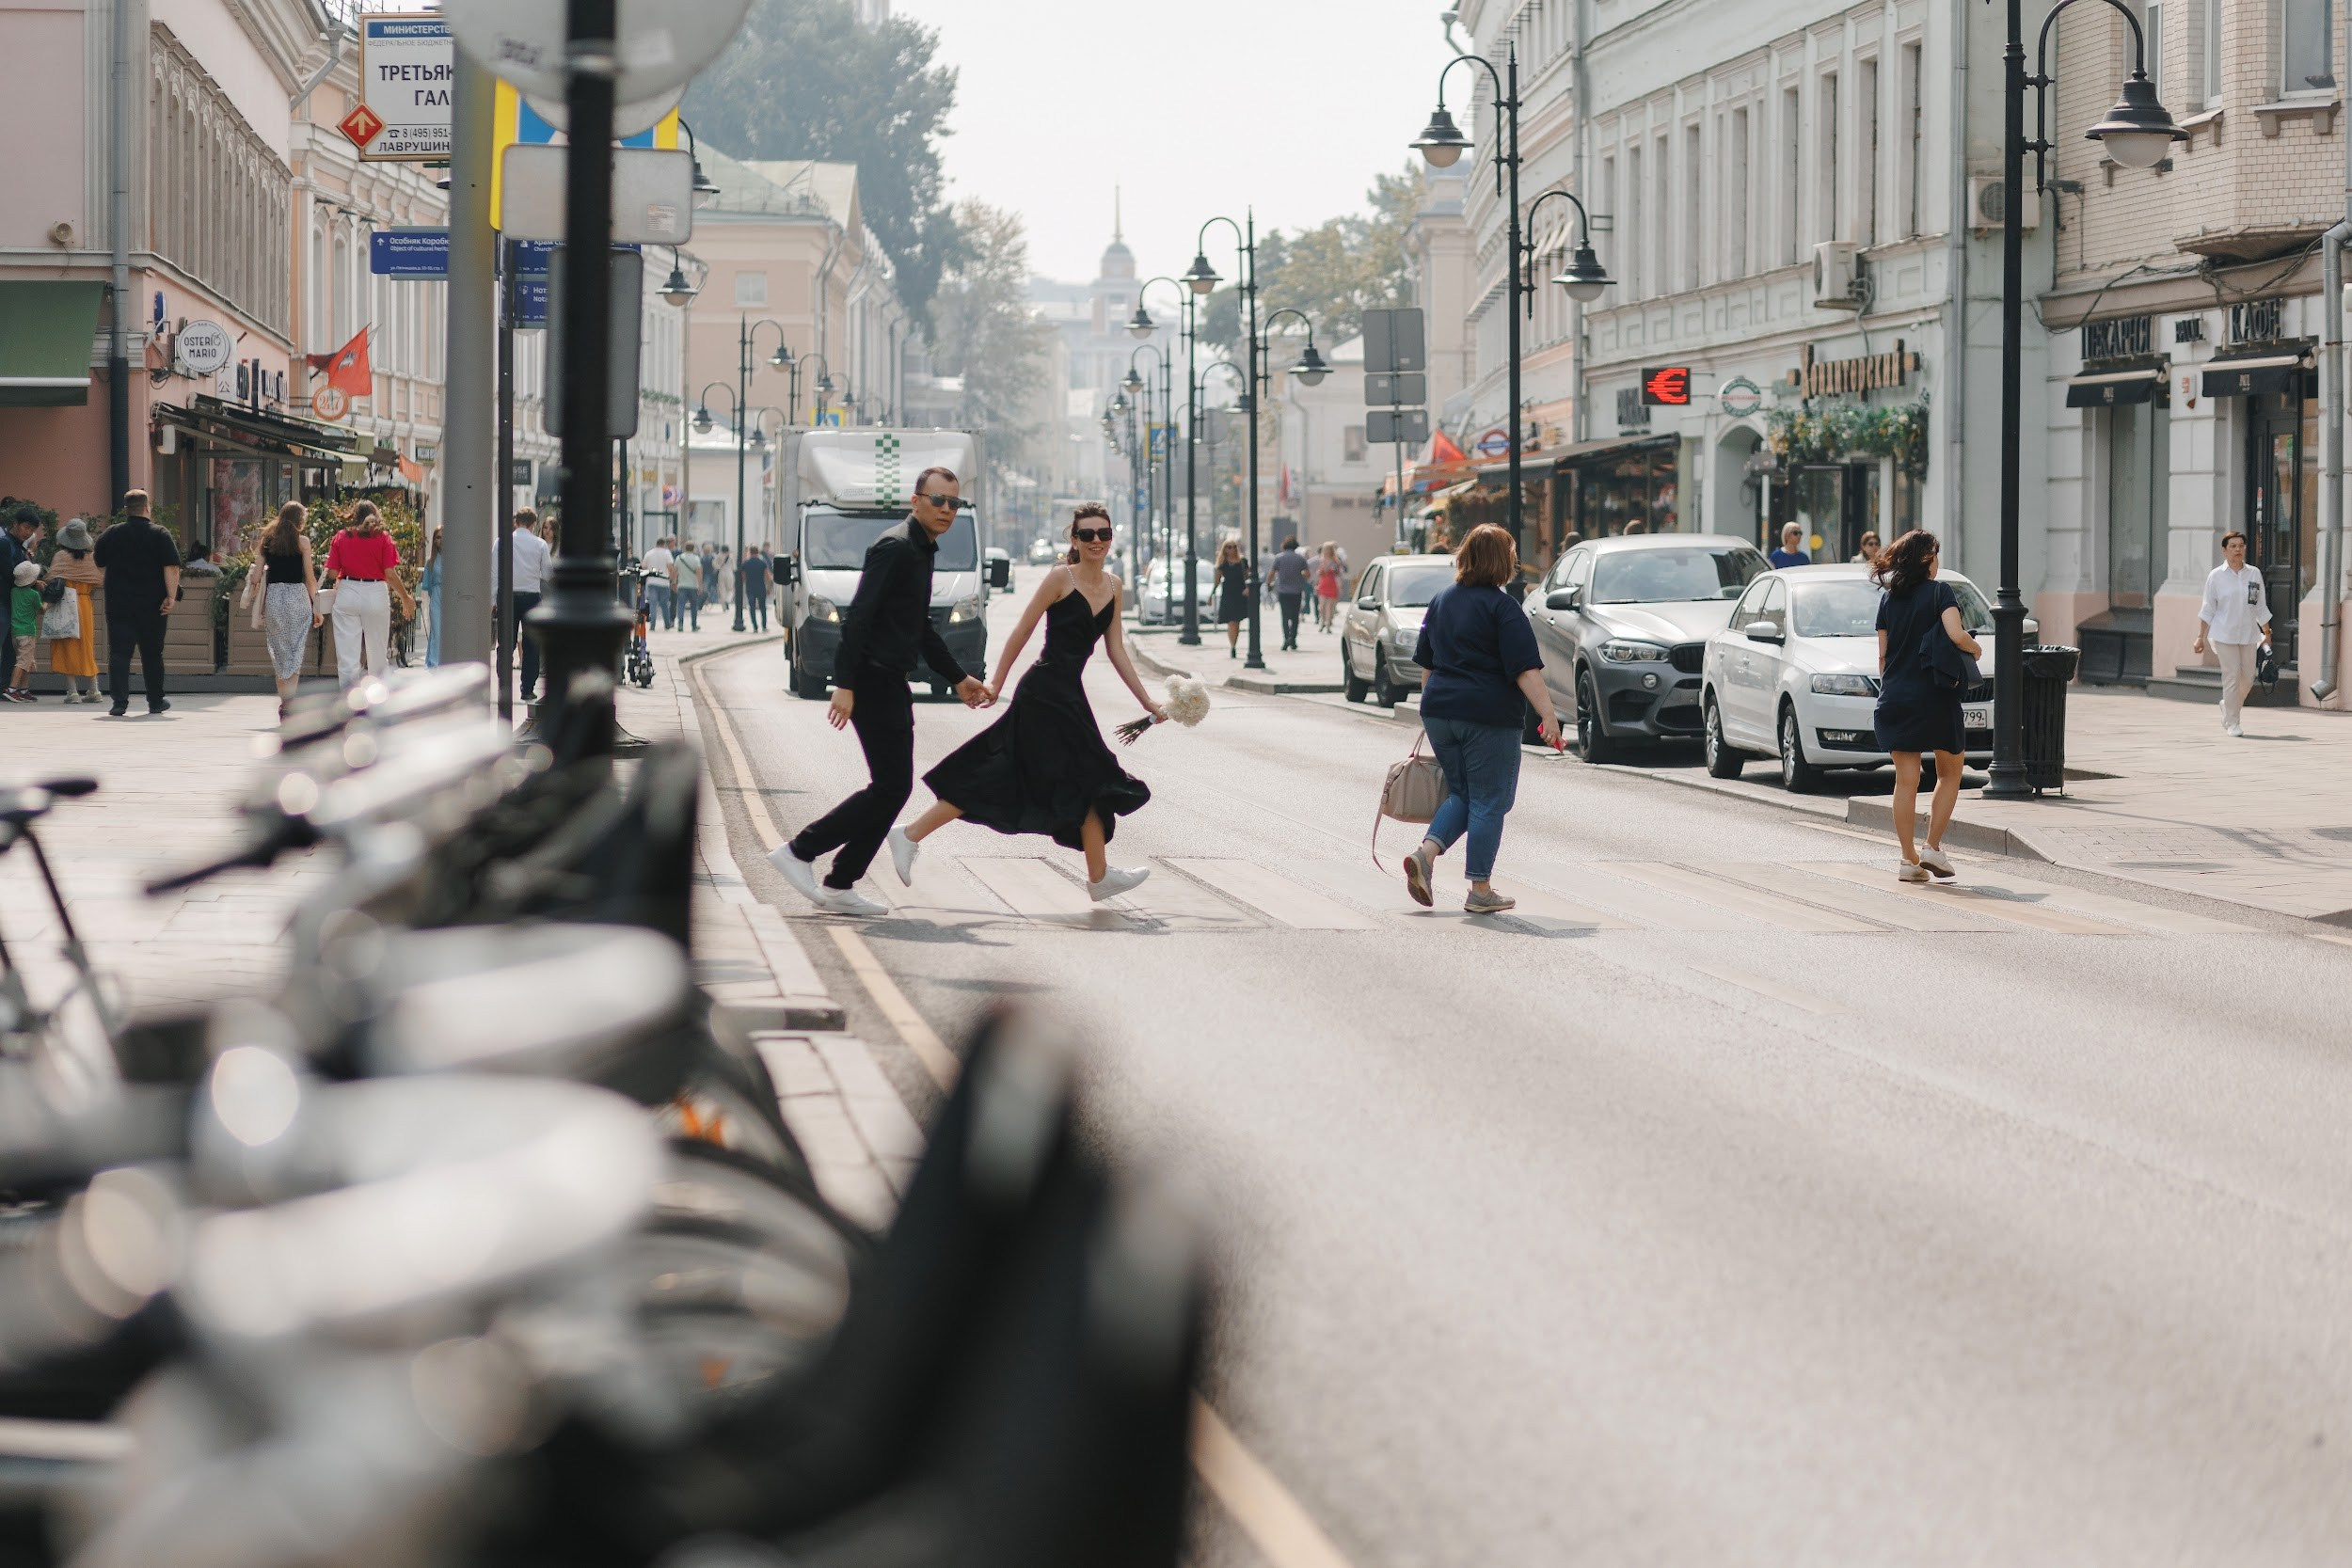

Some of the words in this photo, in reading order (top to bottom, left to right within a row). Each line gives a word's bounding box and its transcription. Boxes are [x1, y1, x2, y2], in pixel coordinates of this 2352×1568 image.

[402, 129, 408, 138] 8
[409, 129, 431, 140] (495)
[189, 349, 216, 357] MARIO
